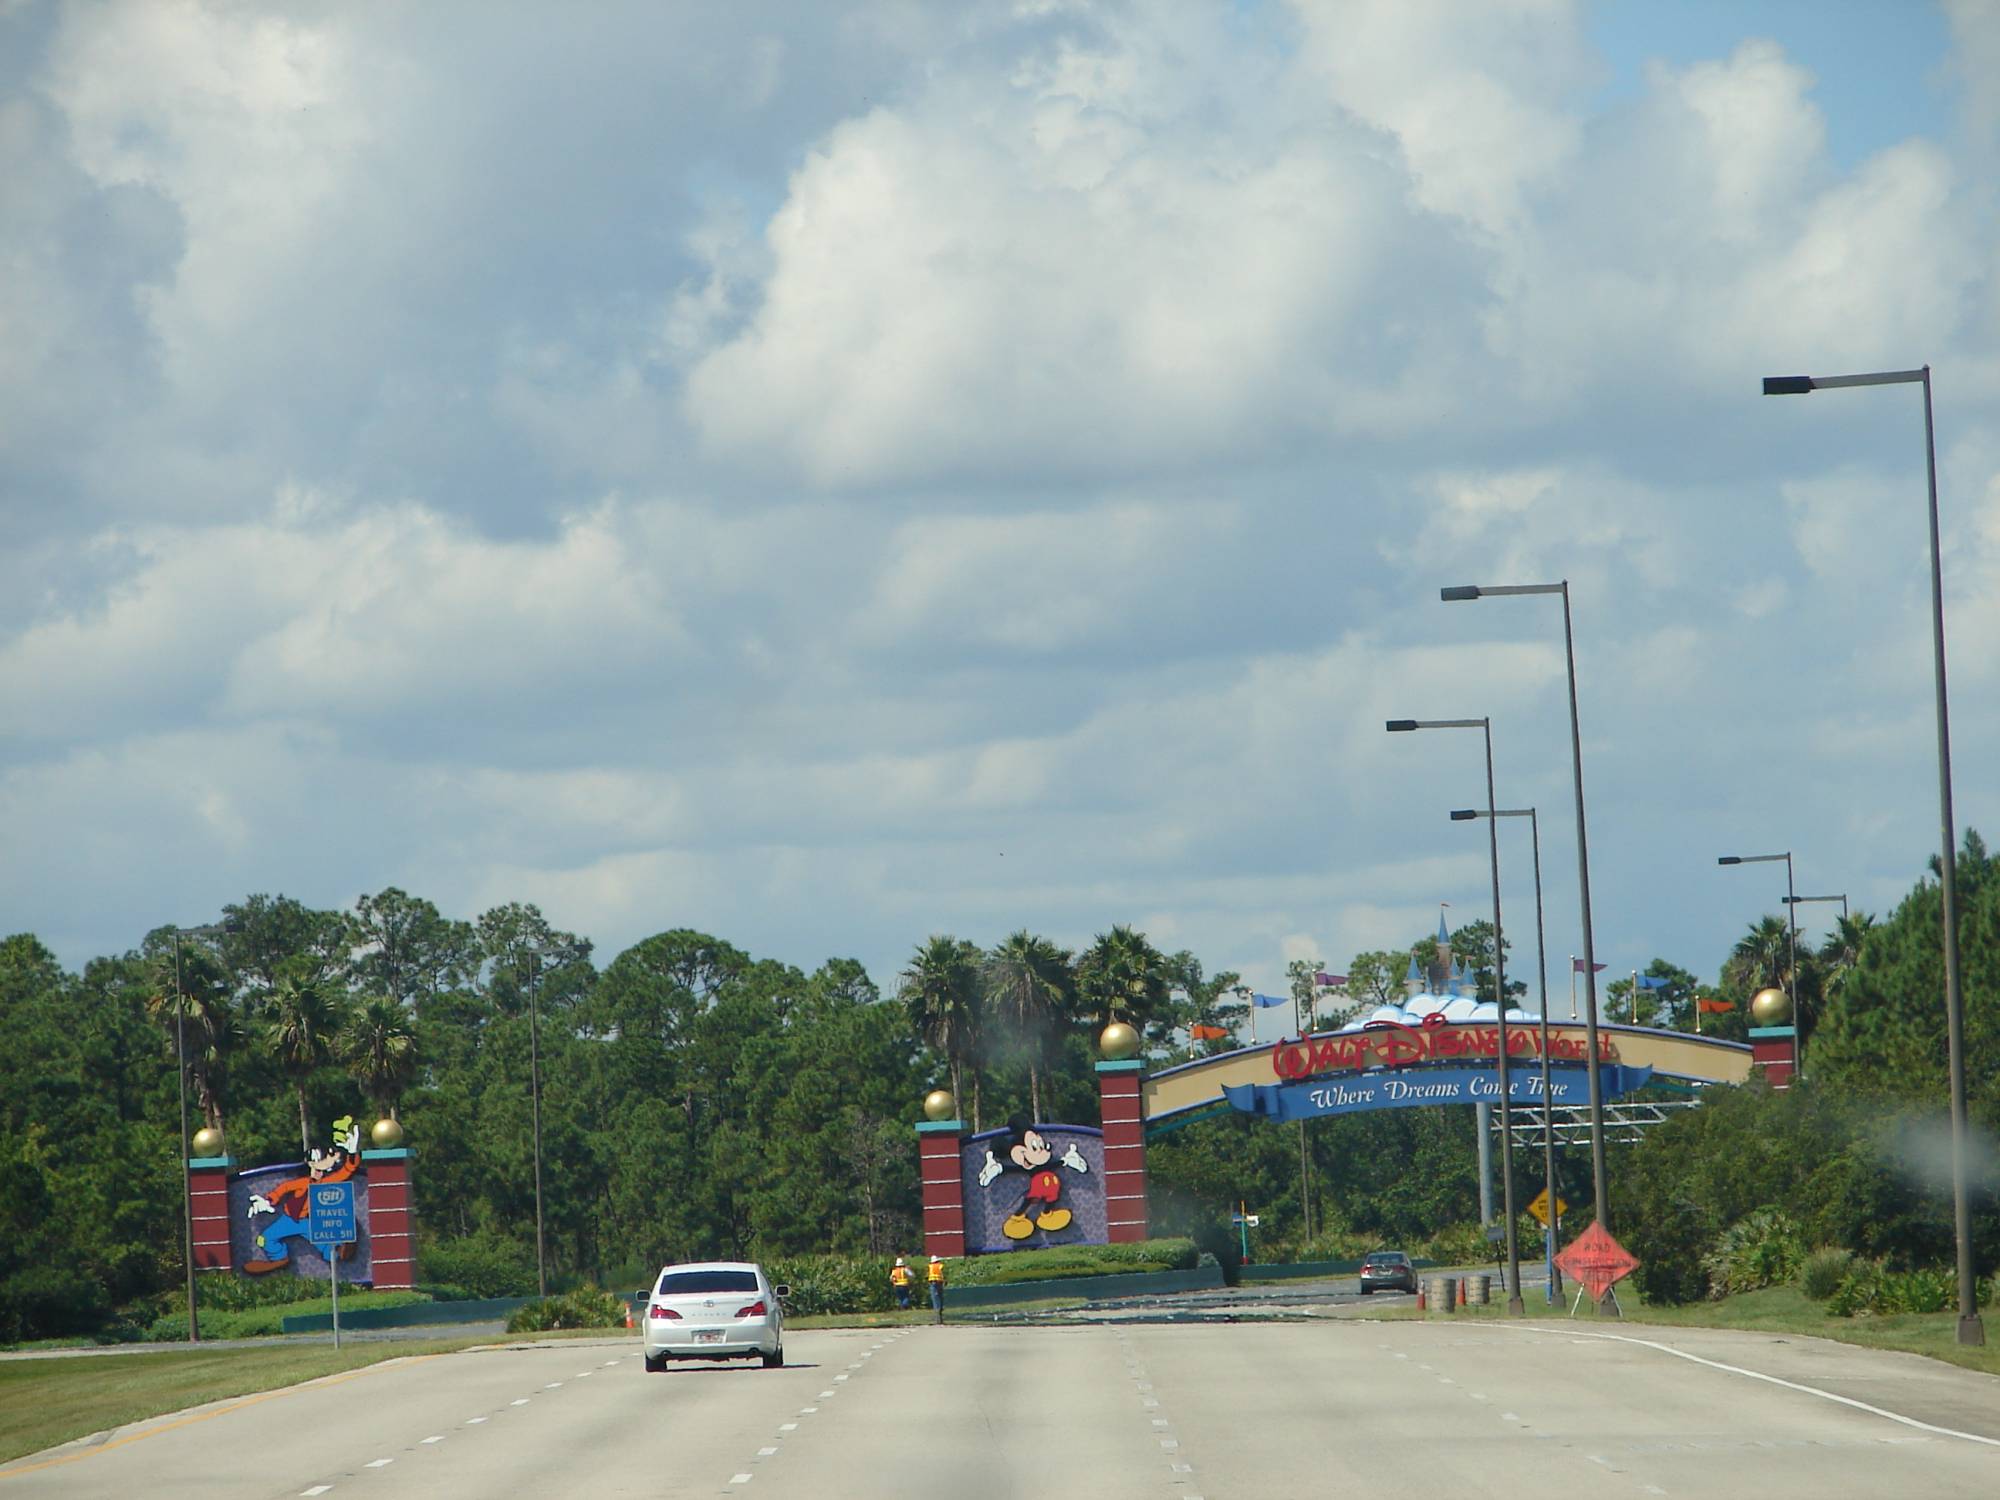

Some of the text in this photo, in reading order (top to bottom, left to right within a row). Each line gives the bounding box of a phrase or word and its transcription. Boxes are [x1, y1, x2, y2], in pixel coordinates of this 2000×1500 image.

[1310, 1085, 1375, 1109] Where
[1384, 1080, 1461, 1100] Dreams
[316, 1208, 348, 1217] TRAVEL
[322, 1219, 343, 1228] INFO
[313, 1229, 353, 1240] CALL 511
